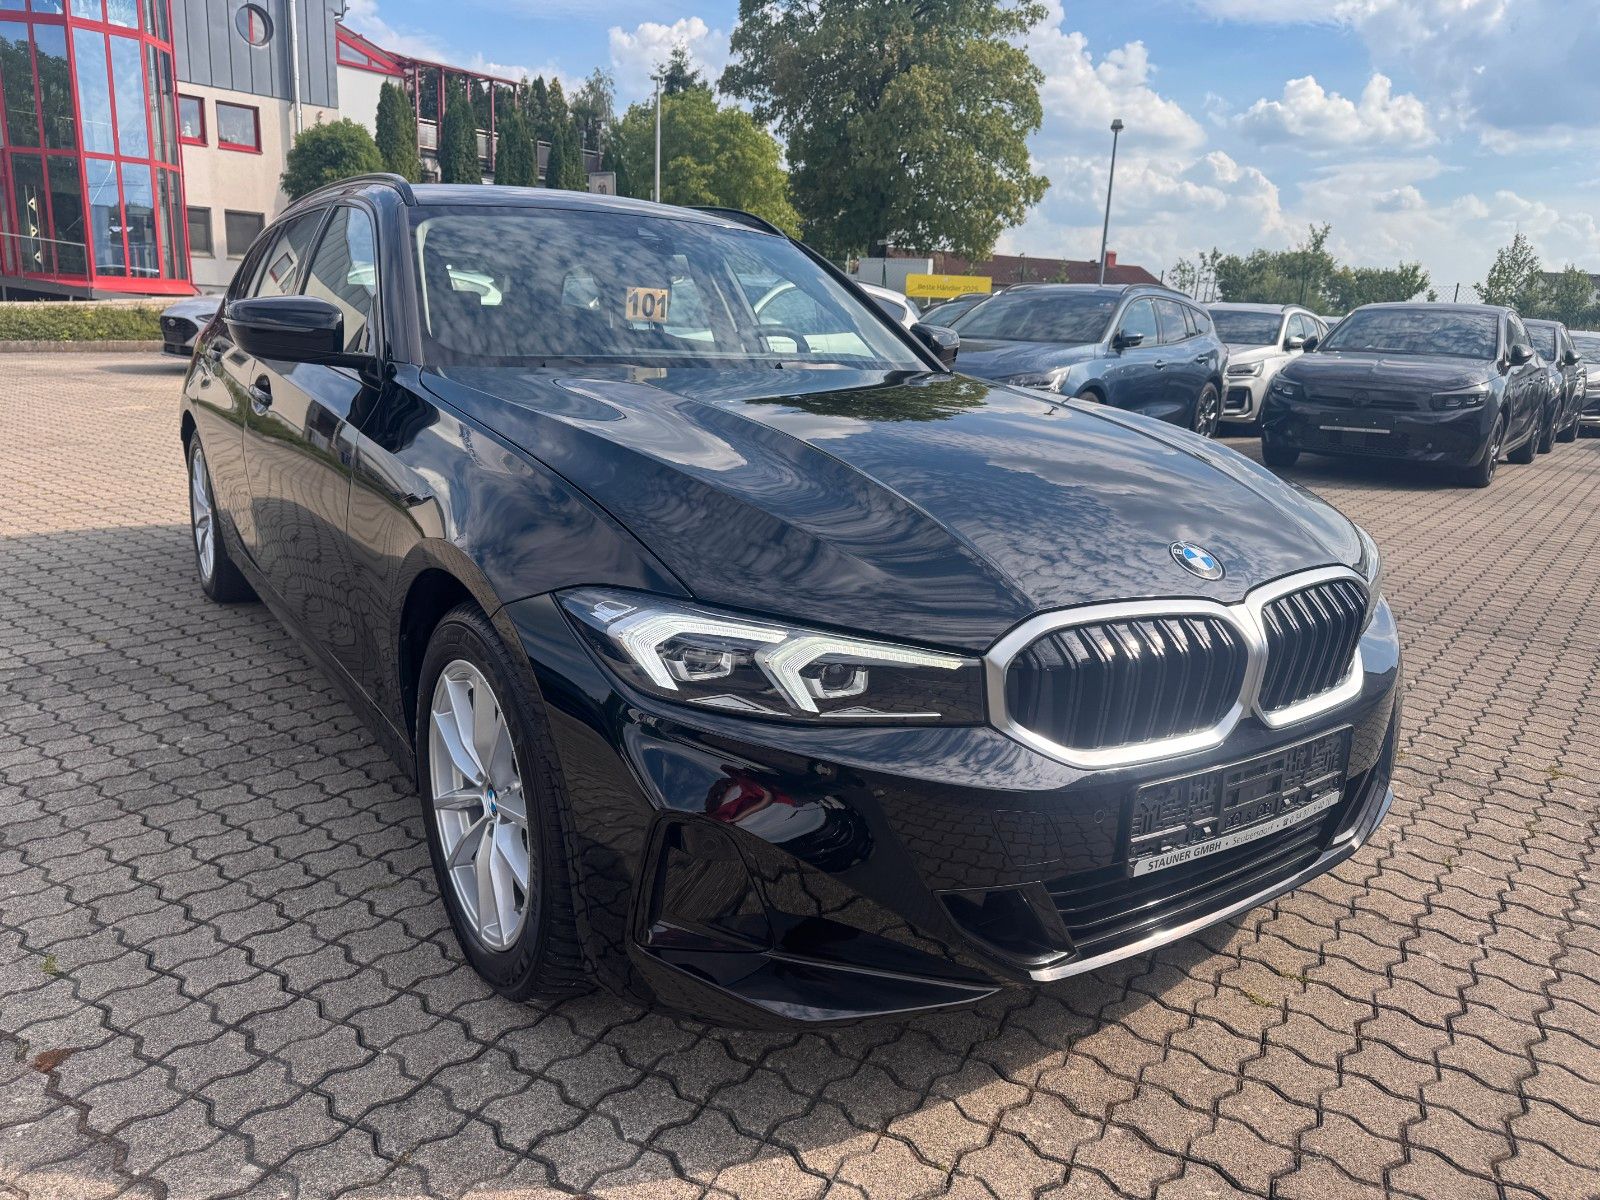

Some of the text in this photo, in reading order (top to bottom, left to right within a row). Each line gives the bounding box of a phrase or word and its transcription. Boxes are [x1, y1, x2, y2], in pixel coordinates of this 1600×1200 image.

[628, 291, 666, 318] 101
[1147, 850, 1191, 871] STAUNER
[1193, 841, 1222, 857] GMBH
